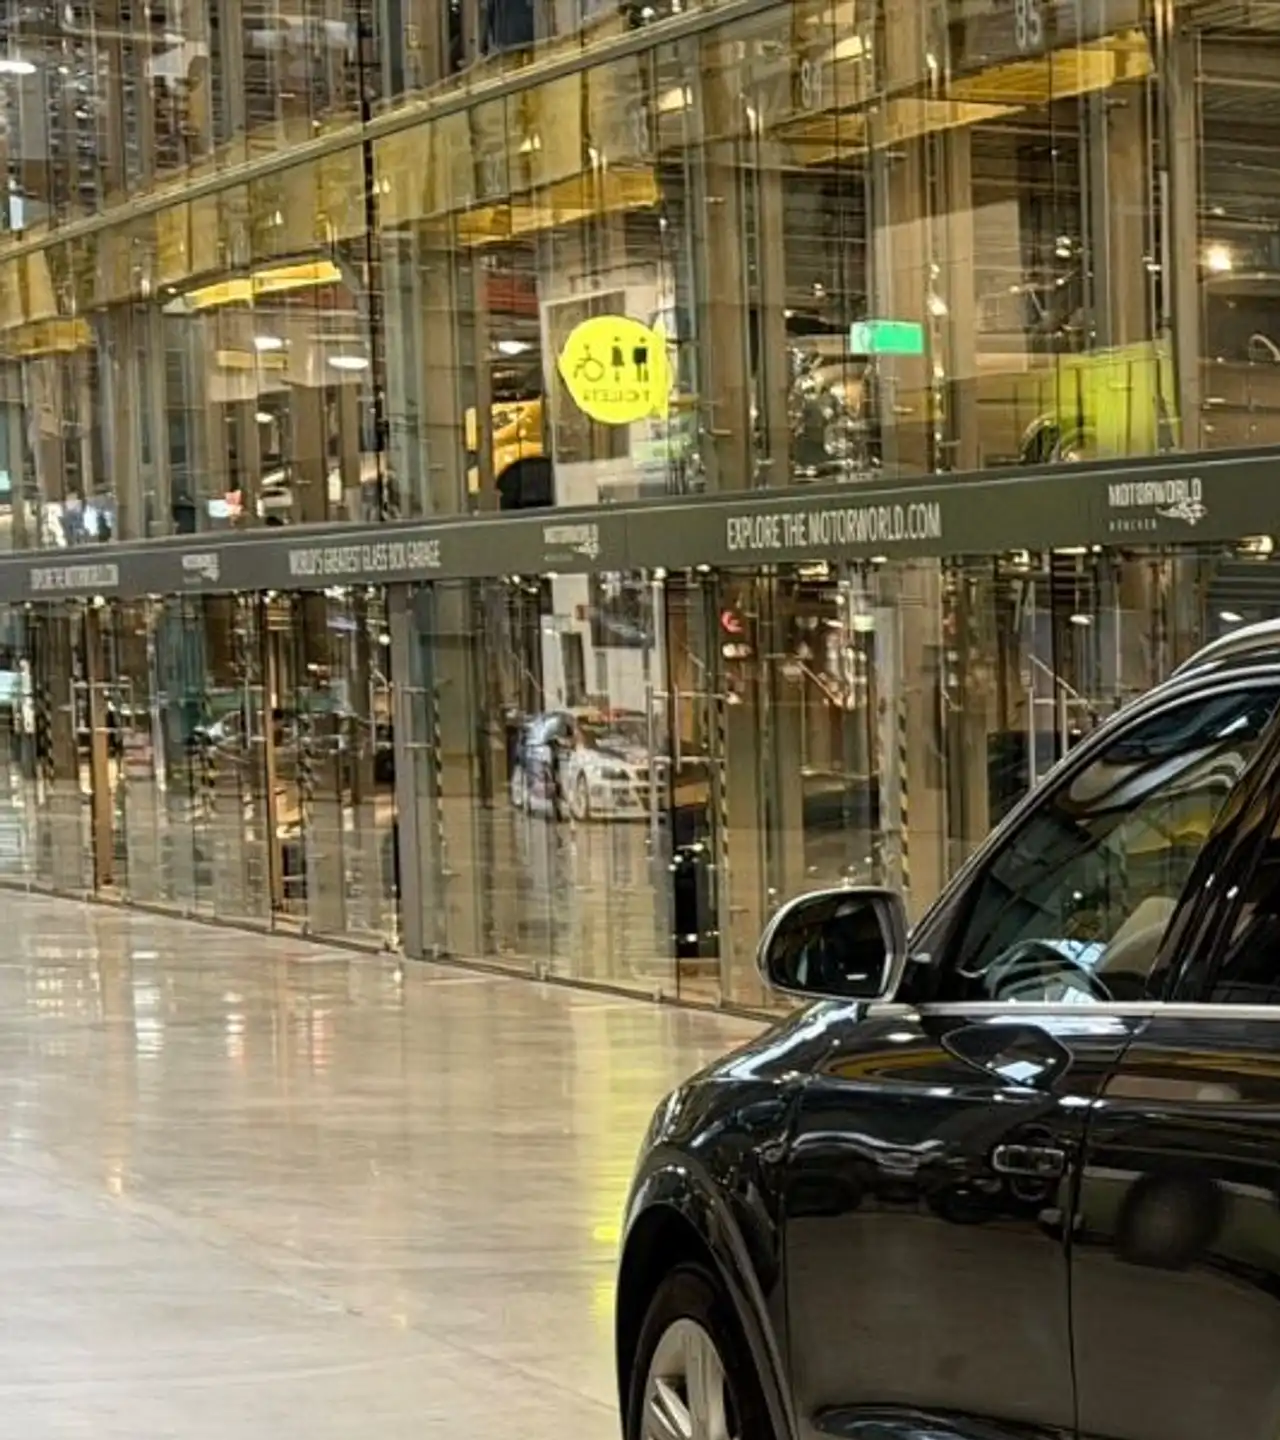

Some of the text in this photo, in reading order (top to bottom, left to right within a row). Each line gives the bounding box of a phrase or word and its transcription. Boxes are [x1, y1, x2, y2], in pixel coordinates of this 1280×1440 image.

[727, 502, 942, 550] EXPLORE THE MOTORWORLD.COM
